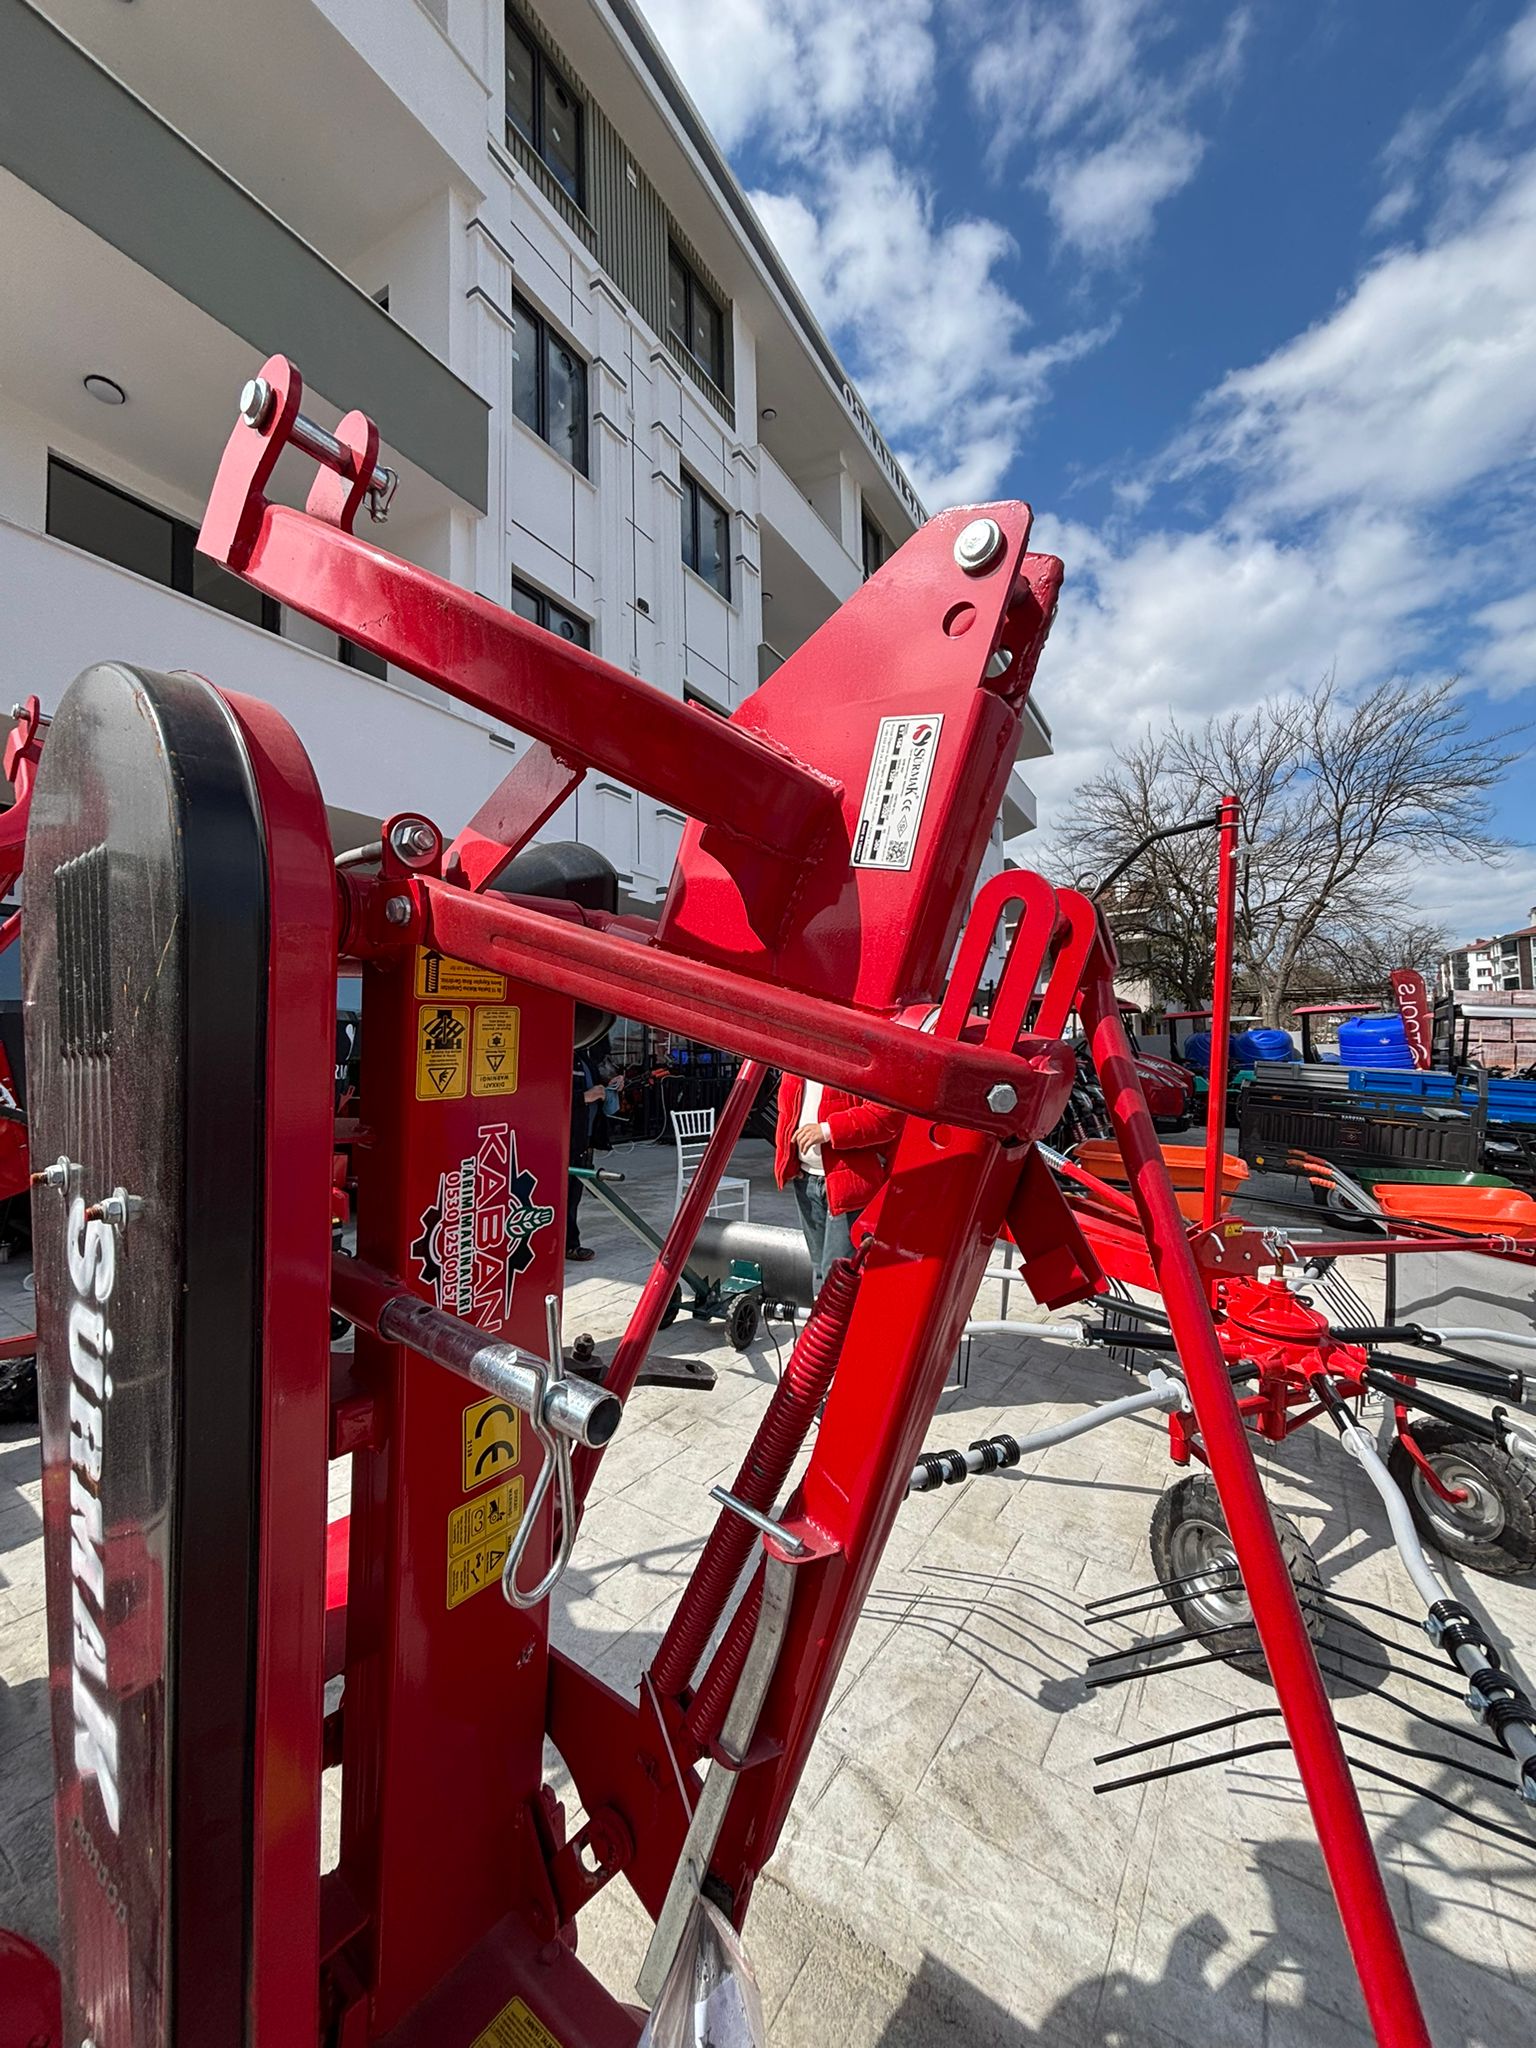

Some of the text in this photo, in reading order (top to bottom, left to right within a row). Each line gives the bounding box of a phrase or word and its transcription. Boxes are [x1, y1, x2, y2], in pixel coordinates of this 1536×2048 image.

[905, 747, 926, 796] SÜRMAK
[457, 1156, 476, 1316] TARIM MAKİNALARI
[474, 1123, 508, 1334] KABAN
[68, 1197, 119, 1835] SÜRMAK
